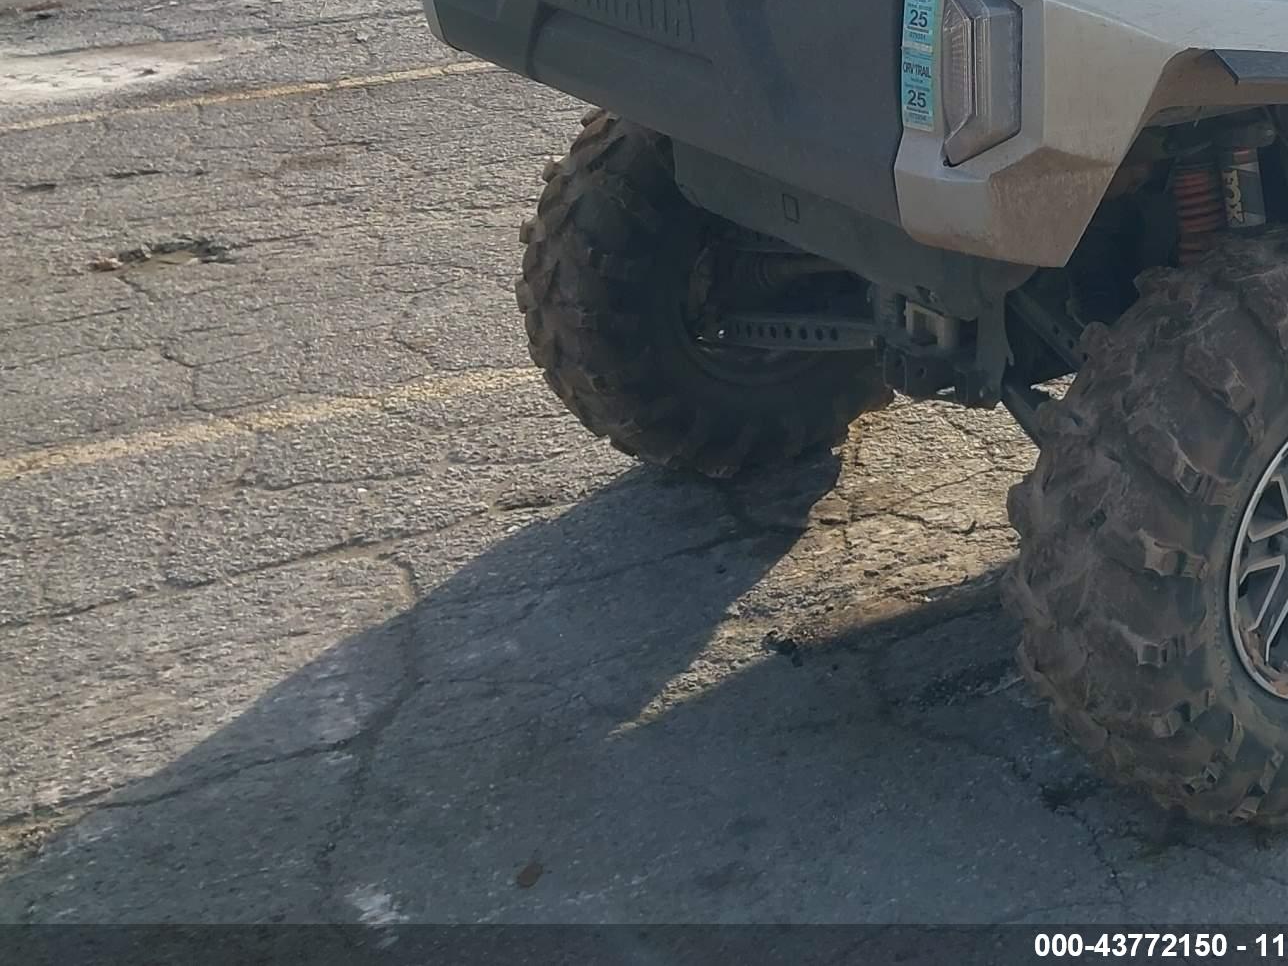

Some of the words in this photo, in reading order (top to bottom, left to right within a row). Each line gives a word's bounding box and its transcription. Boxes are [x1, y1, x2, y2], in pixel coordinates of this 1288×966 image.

[909, 9, 928, 28] 25
[914, 63, 932, 79] TRAIL
[907, 89, 927, 109] 25
